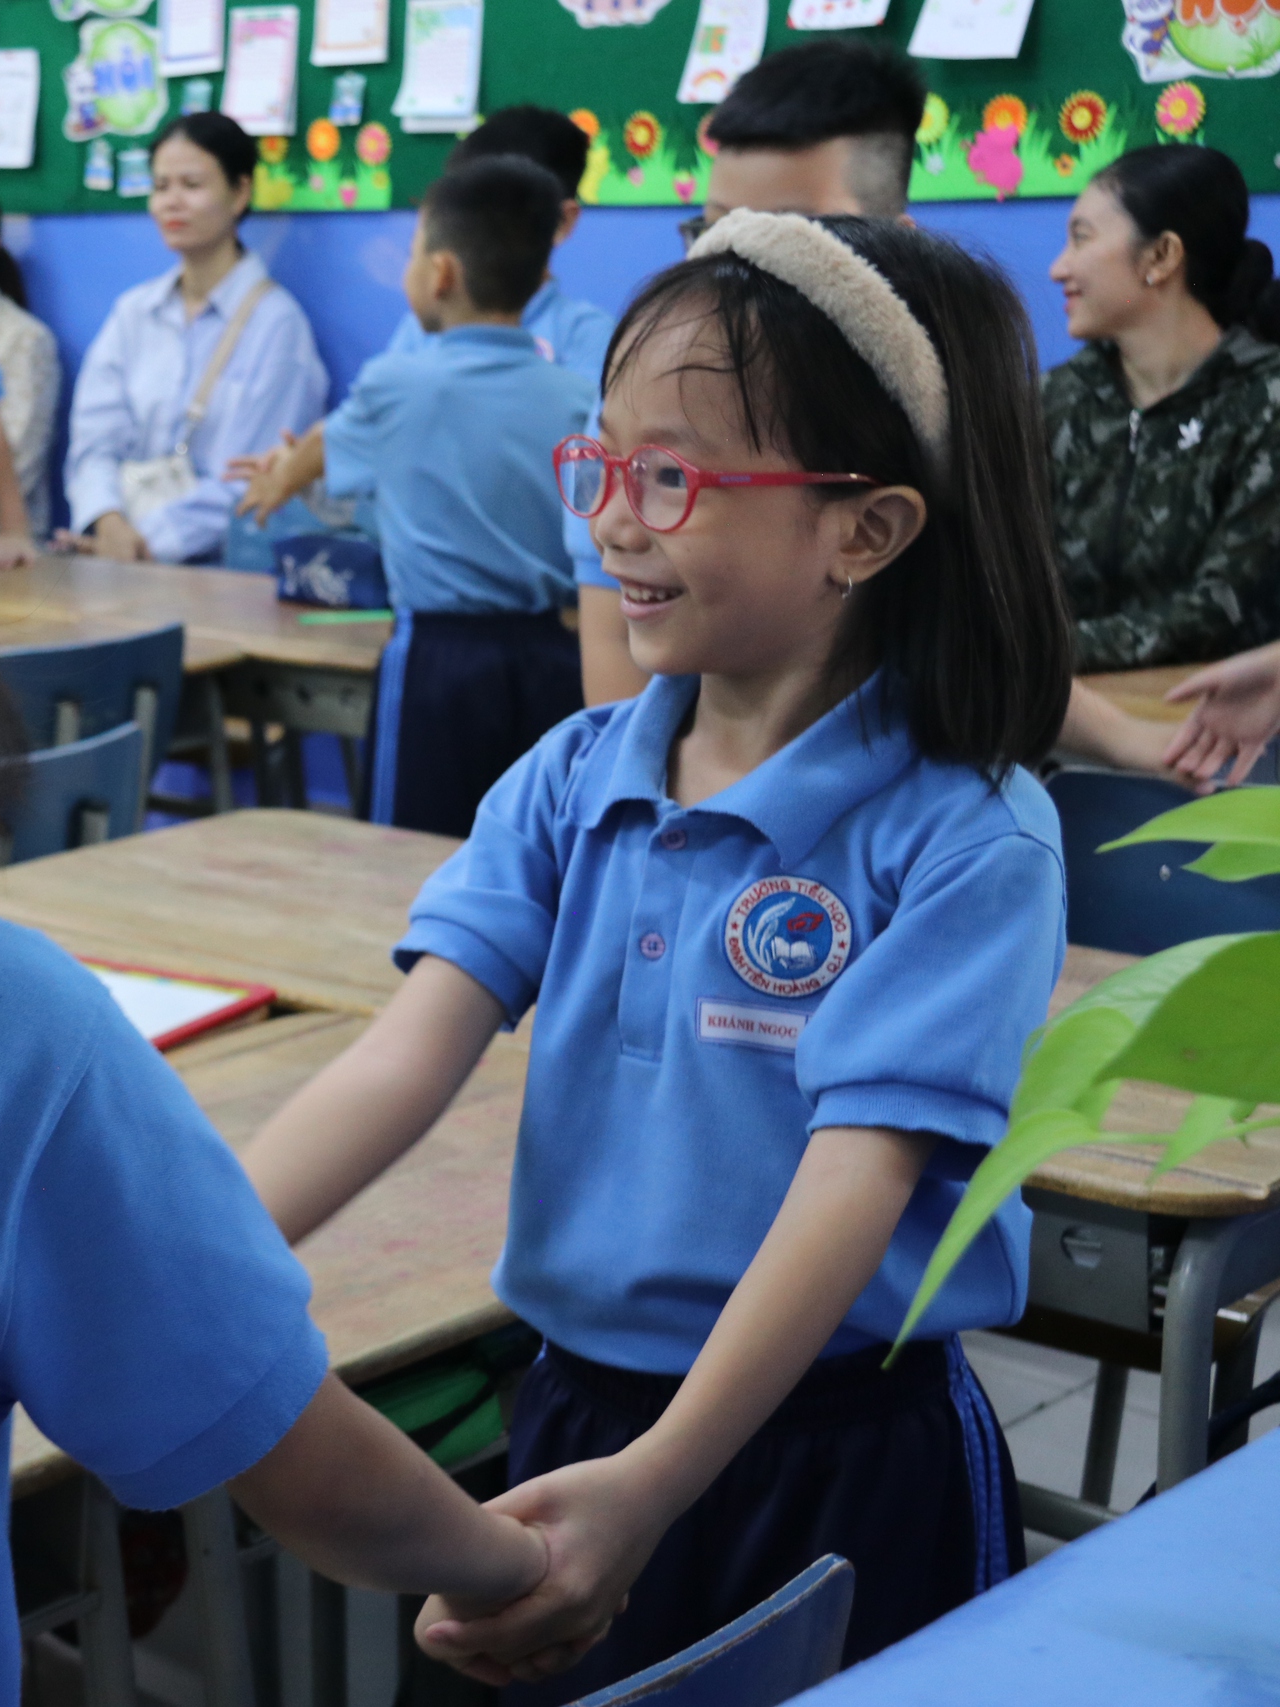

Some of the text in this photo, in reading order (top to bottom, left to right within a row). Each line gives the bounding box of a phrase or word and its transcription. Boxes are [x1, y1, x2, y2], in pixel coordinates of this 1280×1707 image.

[773, 978, 821, 995] HOÀNG
[707, 1014, 798, 1040] KHÁNH NGỌC
